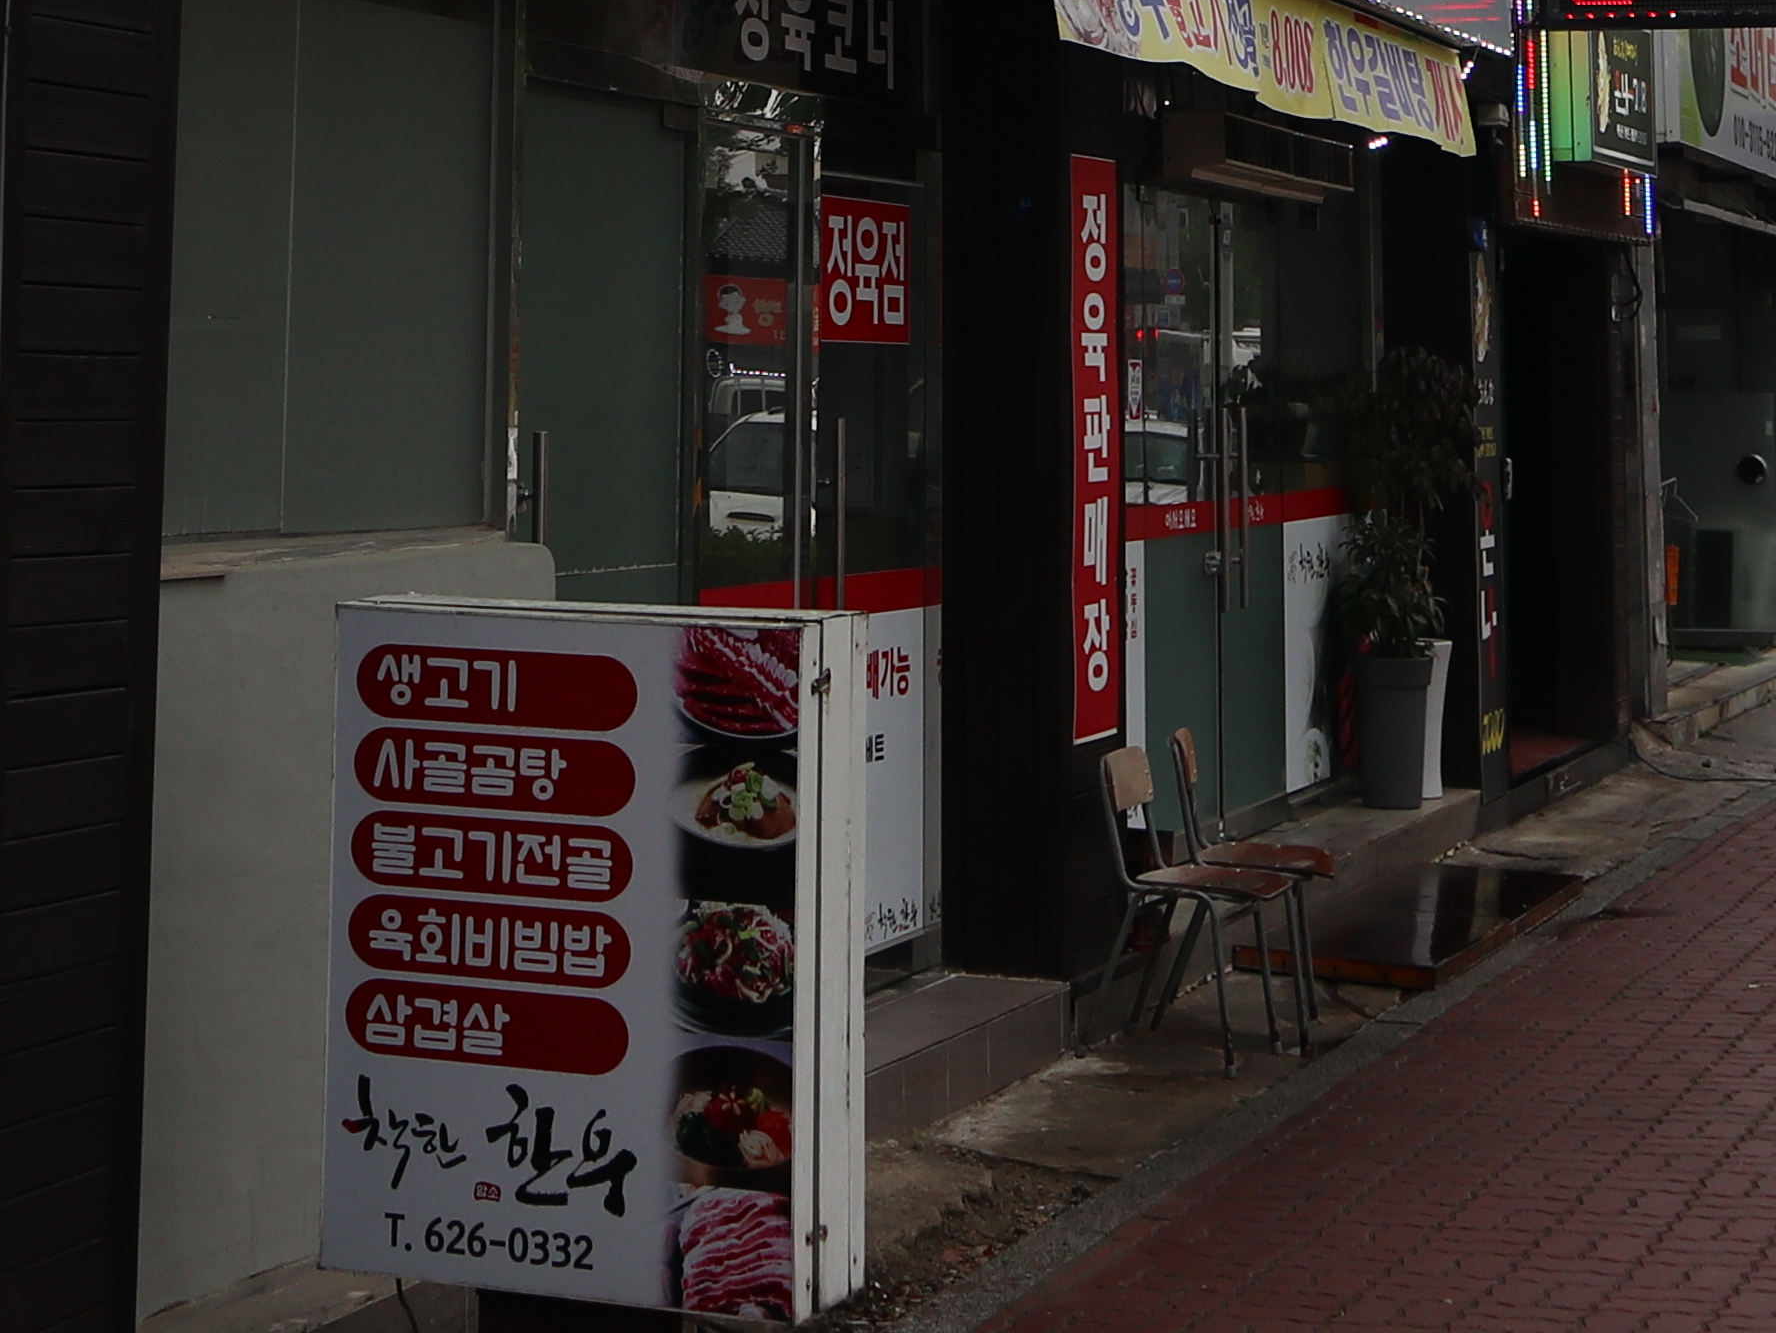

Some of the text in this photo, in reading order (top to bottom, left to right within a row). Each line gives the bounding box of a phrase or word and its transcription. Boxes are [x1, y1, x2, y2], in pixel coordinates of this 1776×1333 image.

[827, 214, 905, 326] 정육점
[1081, 193, 1110, 691] 정육판매장
[376, 654, 518, 712] 생고기
[374, 739, 567, 799] 사골곰탕
[371, 822, 613, 891] 불고기전골
[368, 908, 612, 977] 육회비빔밥
[366, 993, 510, 1056] 삼겹살
[341, 1075, 638, 1218] 착한 한우
[475, 1182, 501, 1202] 암소
[385, 1214, 594, 1271] T. 626-0332
